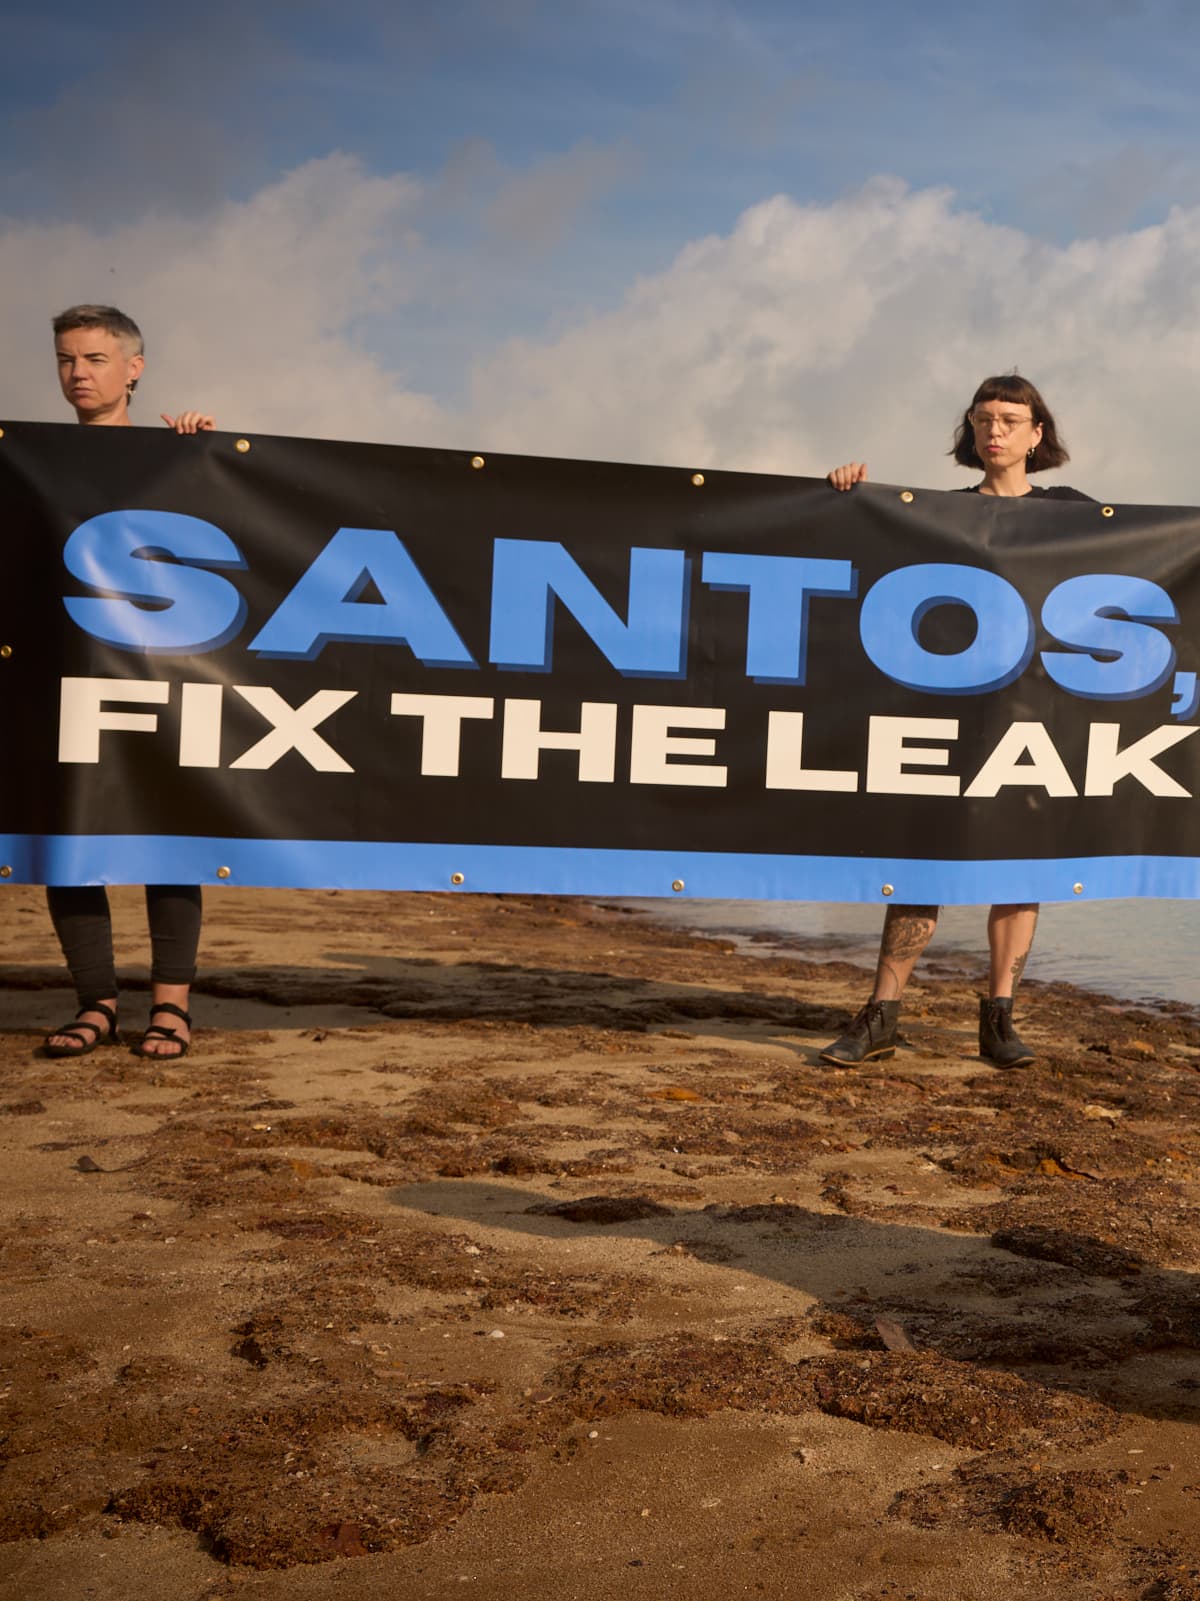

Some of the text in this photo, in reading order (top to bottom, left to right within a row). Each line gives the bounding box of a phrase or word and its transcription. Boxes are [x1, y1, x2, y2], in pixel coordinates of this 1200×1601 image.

[63, 509, 1200, 720] SANTOS,
[58, 677, 358, 773] FIX
[391, 693, 728, 788] THE
